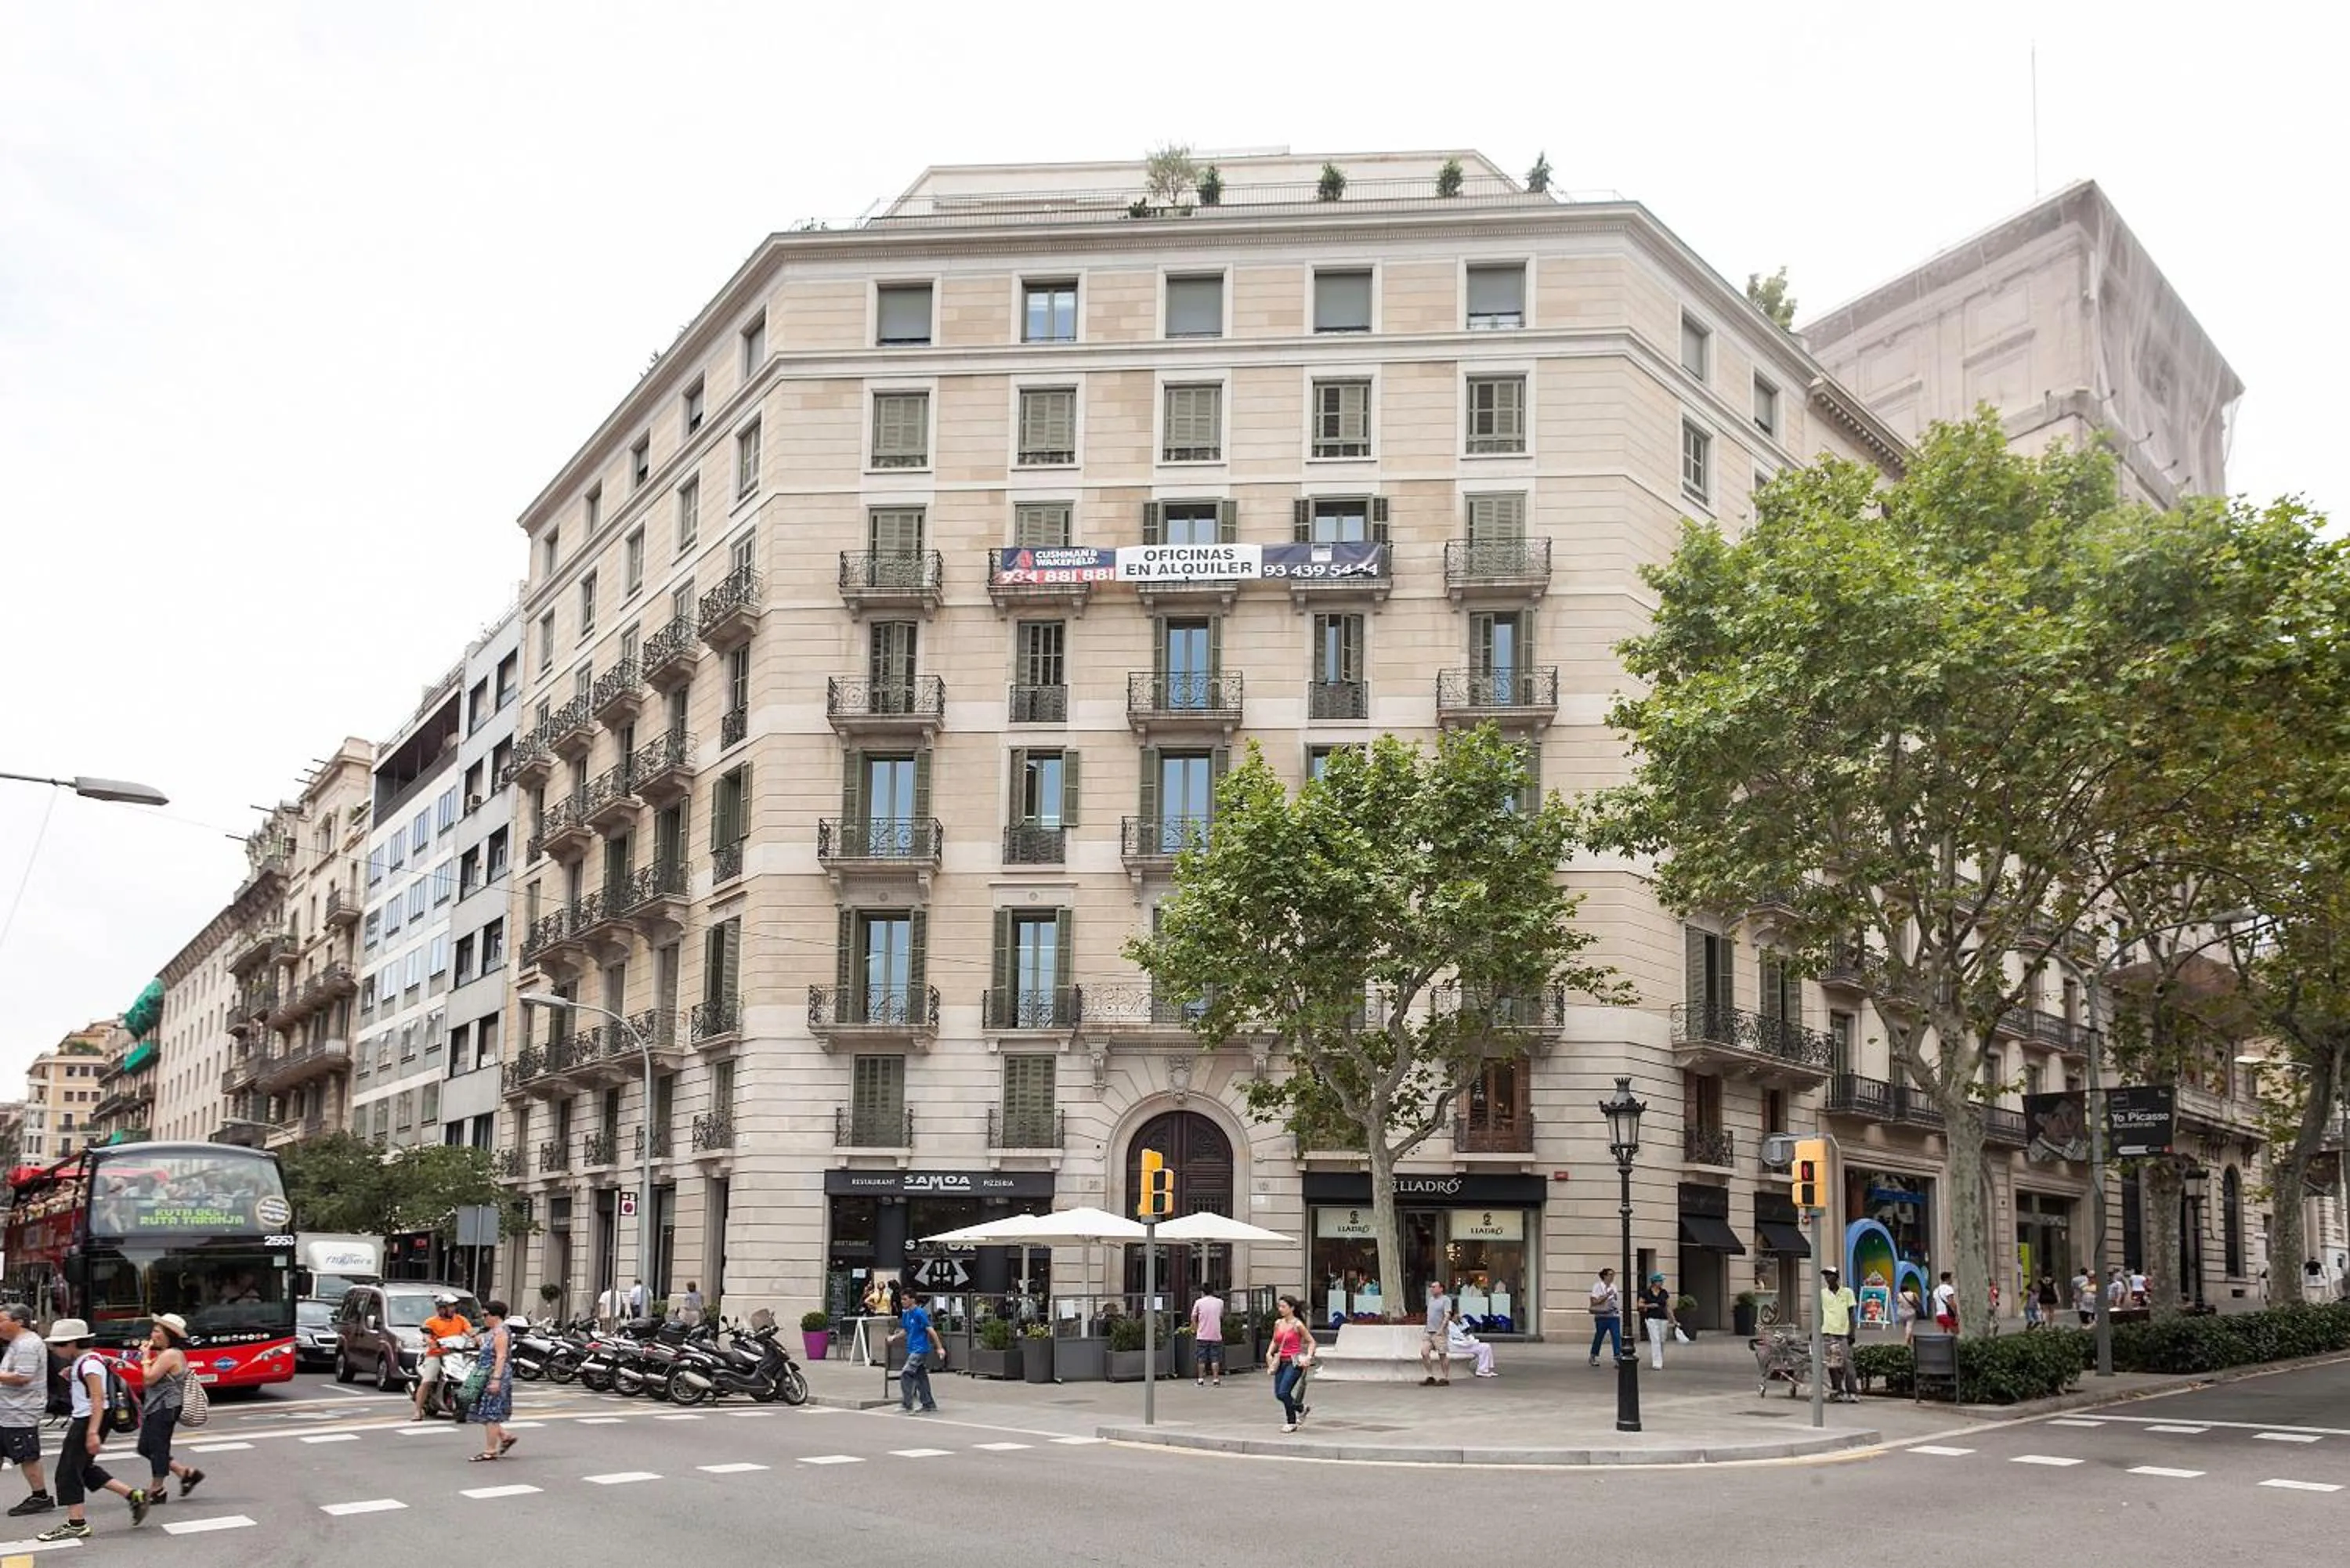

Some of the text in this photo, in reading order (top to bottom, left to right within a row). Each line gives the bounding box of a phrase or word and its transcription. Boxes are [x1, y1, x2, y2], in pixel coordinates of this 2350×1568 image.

[1035, 550, 1090, 558] CUSHMAN
[1144, 549, 1235, 561] OFICINAS
[1126, 562, 1253, 576] EN ALQUILER
[1264, 565, 1287, 576] 93
[1291, 565, 1326, 576] 439
[1002, 568, 1115, 583] 934 881 881
[2111, 1112, 2169, 1122] Yo Picasso
[904, 1176, 971, 1190] SAMOA
[1400, 1178, 1459, 1194] LLADRÓ
[139, 1216, 178, 1225] RUTA
[264, 1235, 295, 1246] 2553
